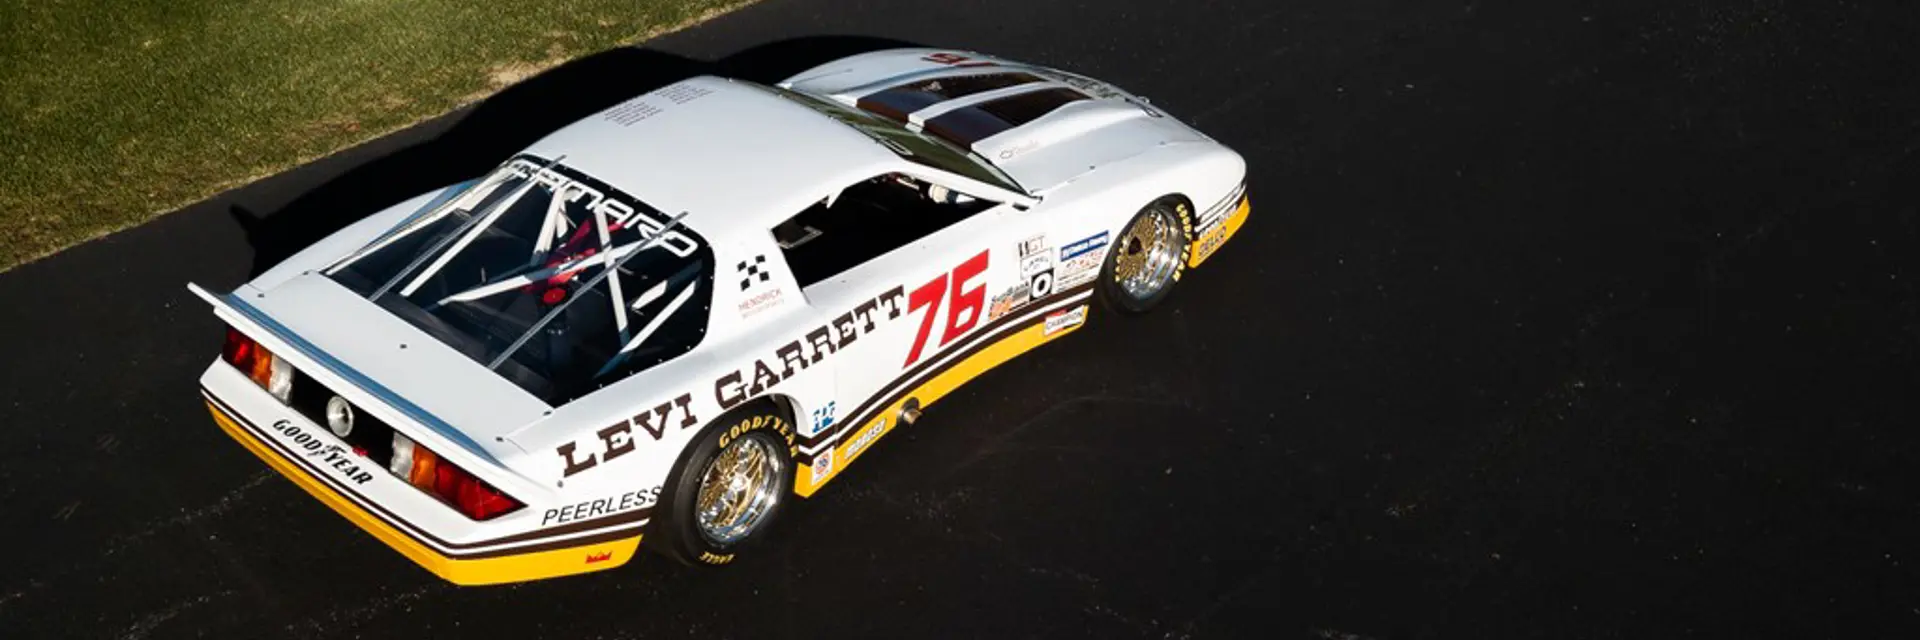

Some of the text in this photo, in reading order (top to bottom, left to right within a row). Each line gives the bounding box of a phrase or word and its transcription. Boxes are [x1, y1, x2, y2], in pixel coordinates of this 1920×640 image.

[903, 249, 990, 369] 76
[556, 285, 905, 477] LEVI GARRETT
[272, 418, 374, 485] GOODYEAR
[718, 414, 799, 459] GOODYEAR
[541, 485, 662, 526] PEERLESS
